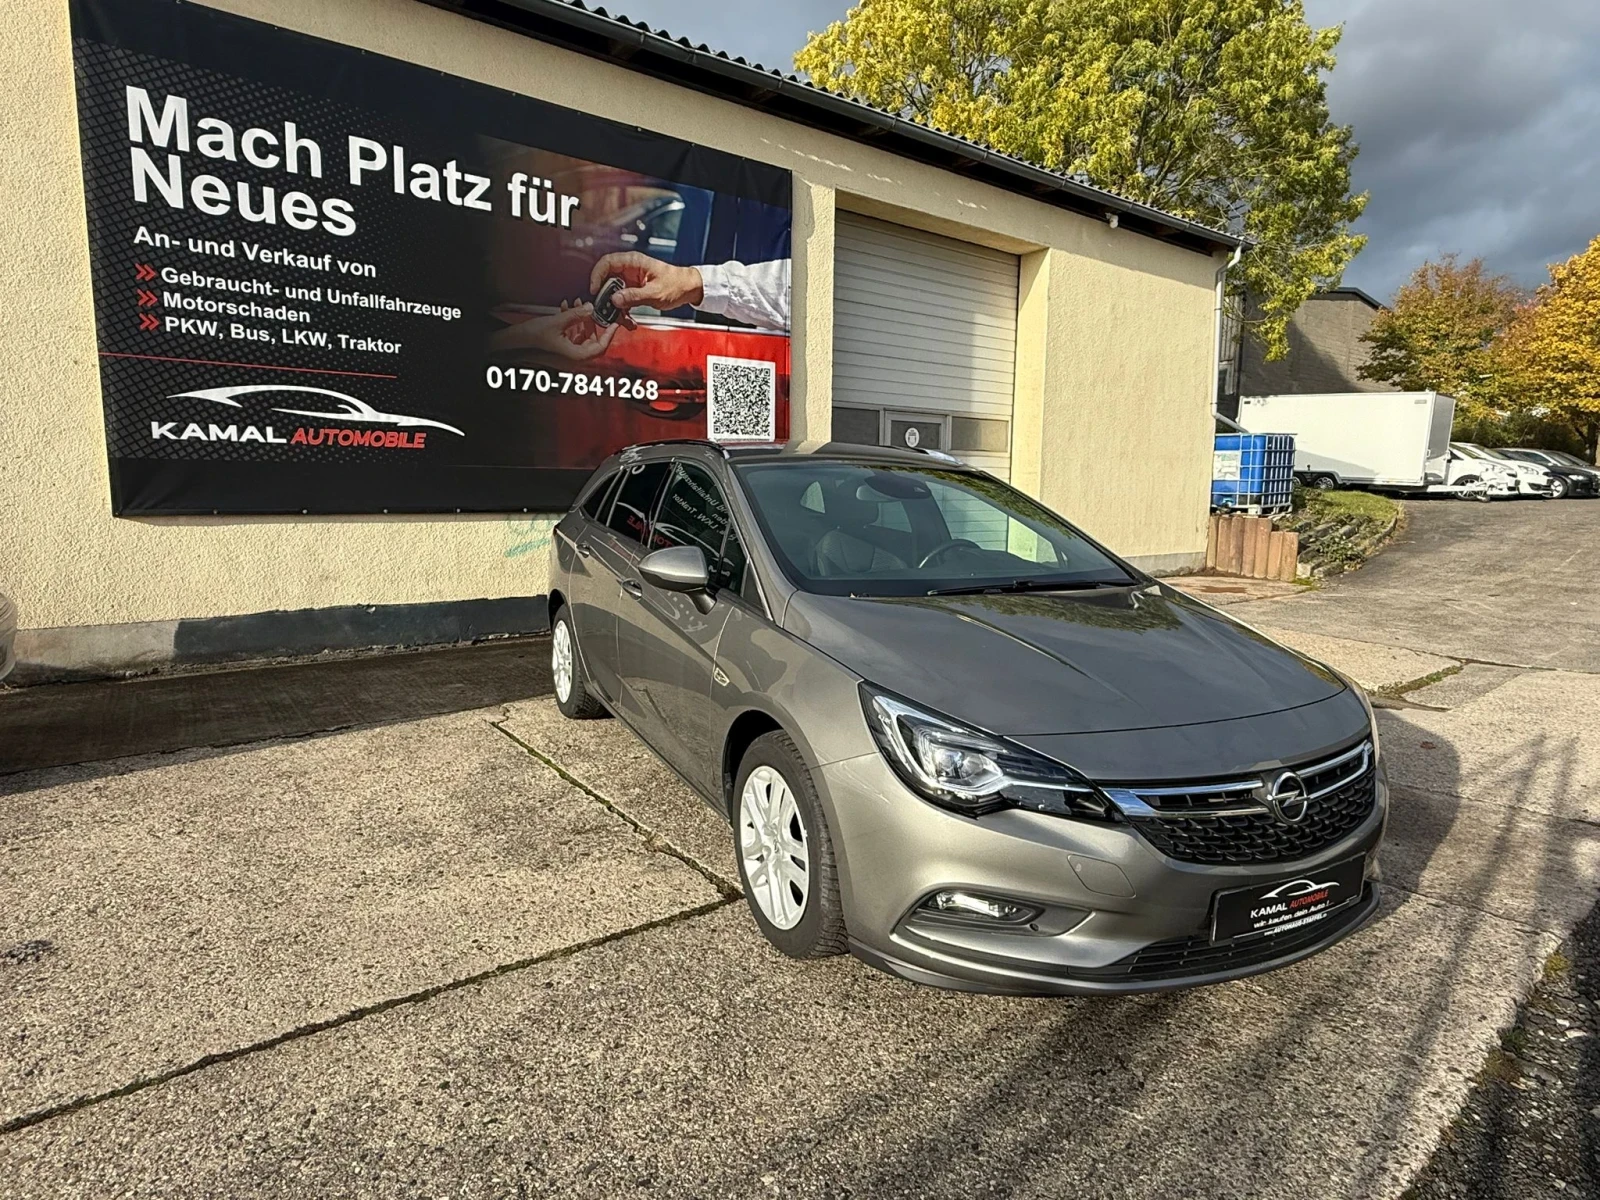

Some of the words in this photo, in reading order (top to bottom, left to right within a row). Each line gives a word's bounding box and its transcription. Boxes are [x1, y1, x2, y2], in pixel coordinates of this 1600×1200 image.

[126, 85, 322, 178] Mach
[348, 134, 492, 212] Platz
[507, 173, 580, 227] für
[130, 146, 357, 237] Neues
[133, 226, 181, 249] An-
[188, 237, 235, 258] und
[241, 242, 331, 272] Verkauf
[337, 260, 377, 278] von
[161, 266, 280, 296] Gebraucht-
[285, 286, 321, 302] und
[327, 288, 462, 321] Unfallfahrzeuge
[163, 291, 311, 324] Motorschaden
[165, 316, 224, 341] PKW,
[230, 323, 276, 345] Bus,
[282, 328, 333, 350] LKW,
[338, 333, 402, 354] Traktor
[486, 366, 659, 400] 0170-7841268
[151, 421, 288, 444] KAMAL
[289, 427, 427, 449] AUTOMOBILE
[1250, 902, 1288, 918] KAMAL
[1289, 889, 1329, 908] AUTOMOBILE
